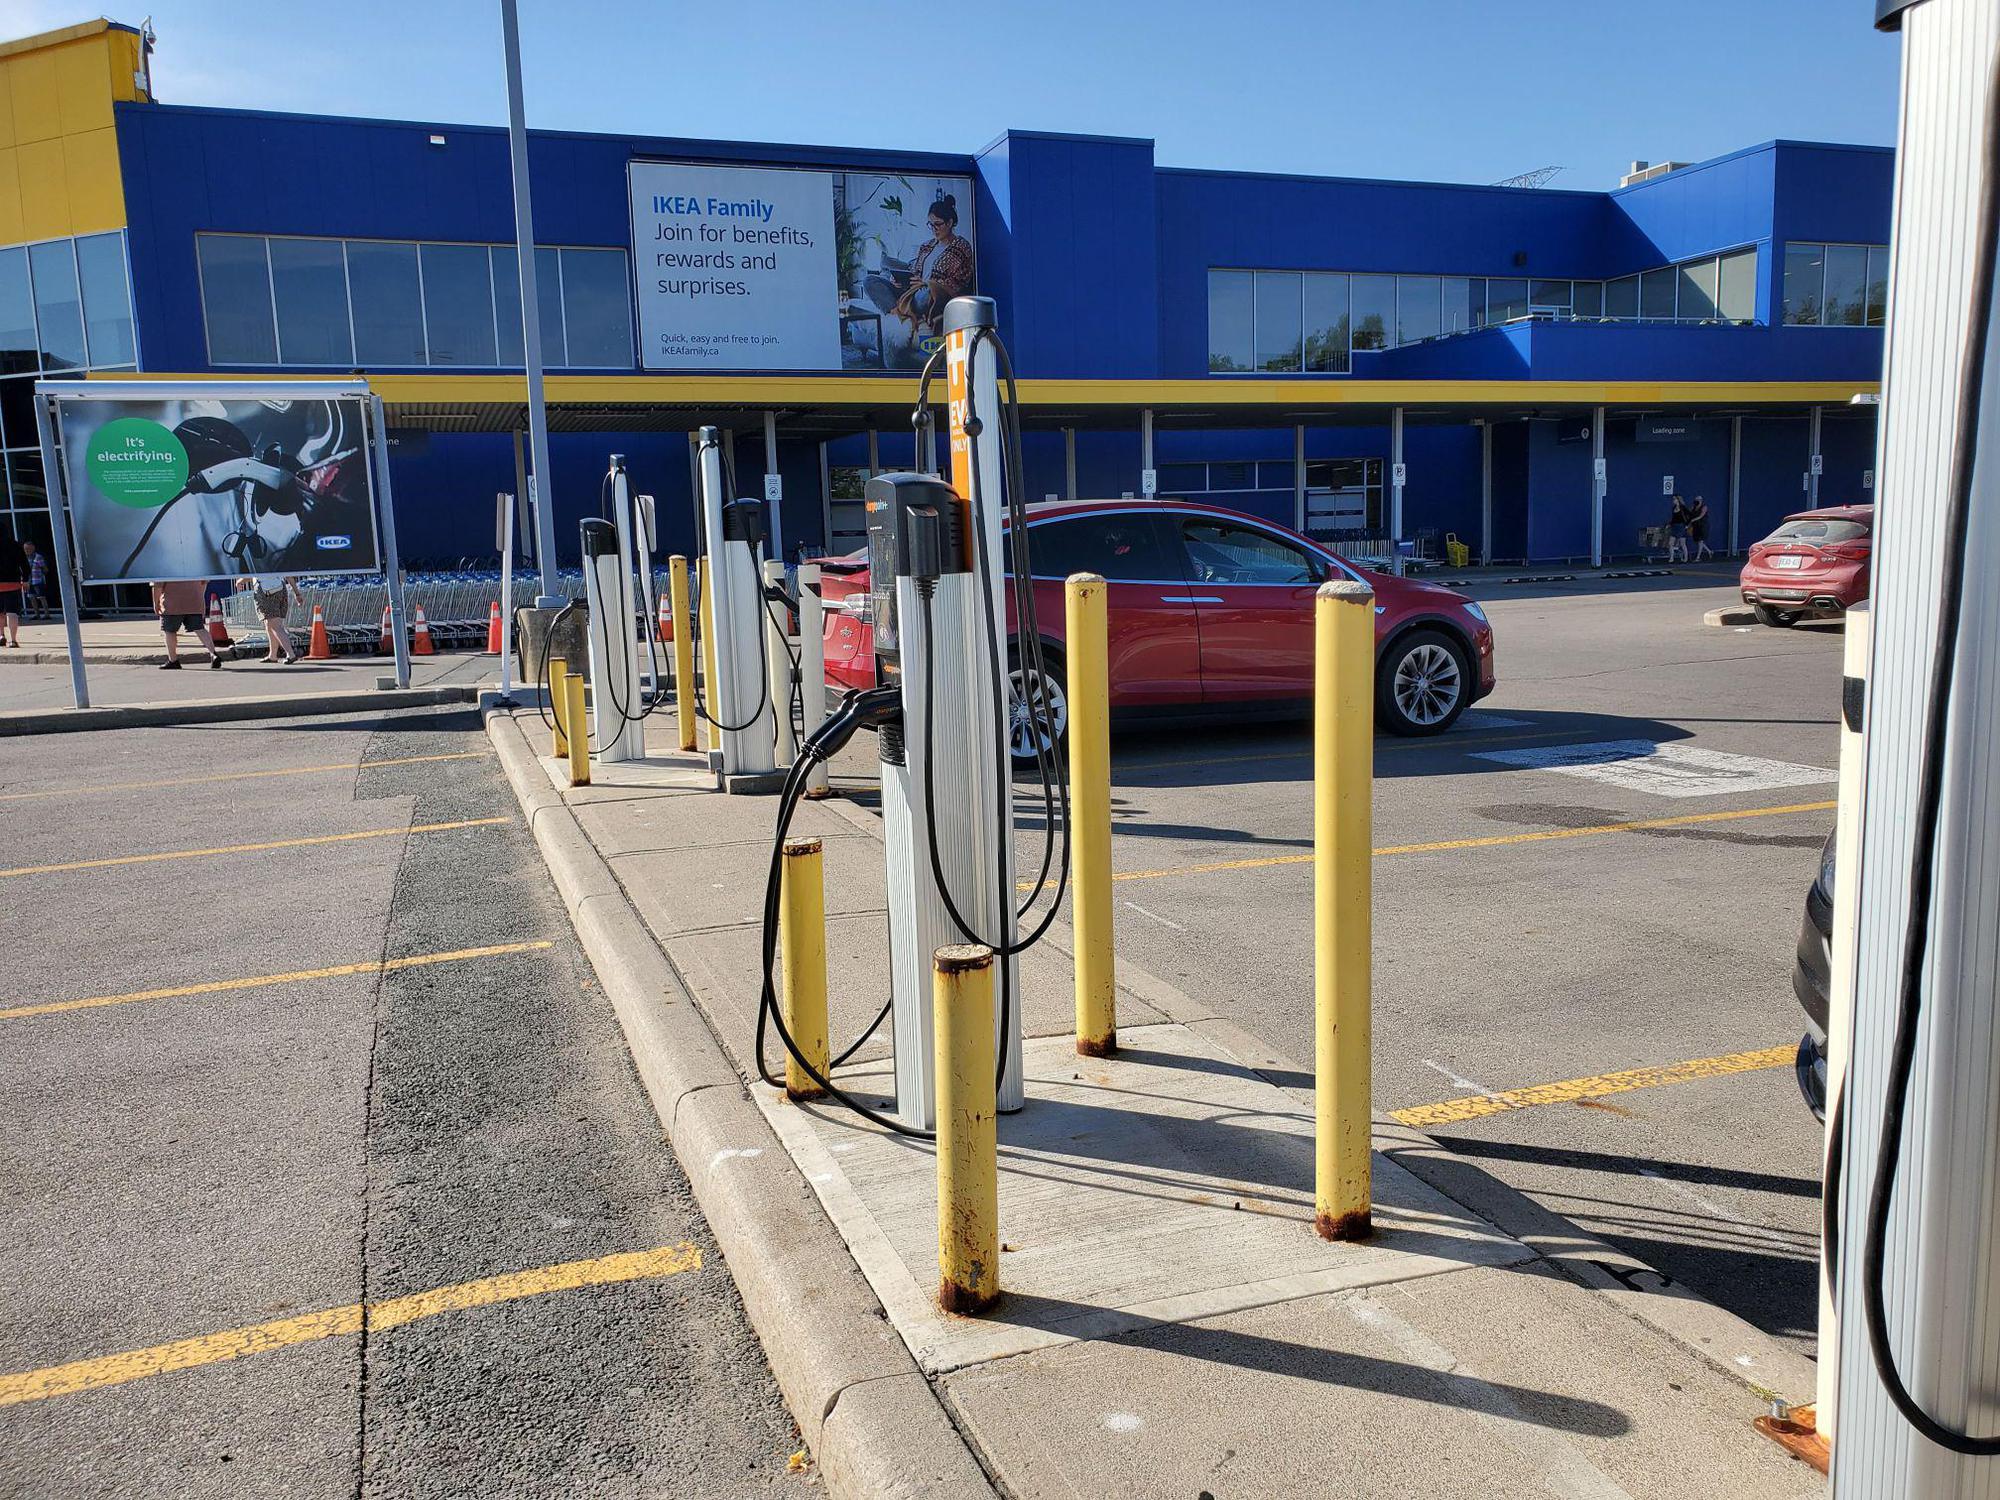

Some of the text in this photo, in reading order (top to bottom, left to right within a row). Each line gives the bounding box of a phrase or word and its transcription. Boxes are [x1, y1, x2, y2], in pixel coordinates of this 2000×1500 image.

[653, 196, 774, 223] IKEA Family
[655, 223, 815, 248] Join for benefits,
[657, 251, 777, 270] rewards and
[658, 277, 751, 299] surprises.
[661, 334, 780, 346] Quick, easy and free to join.
[662, 346, 719, 357] IKEAfamily.ca
[951, 399, 966, 427] EV
[125, 437, 145, 447] It's
[97, 450, 176, 464] electrifying.
